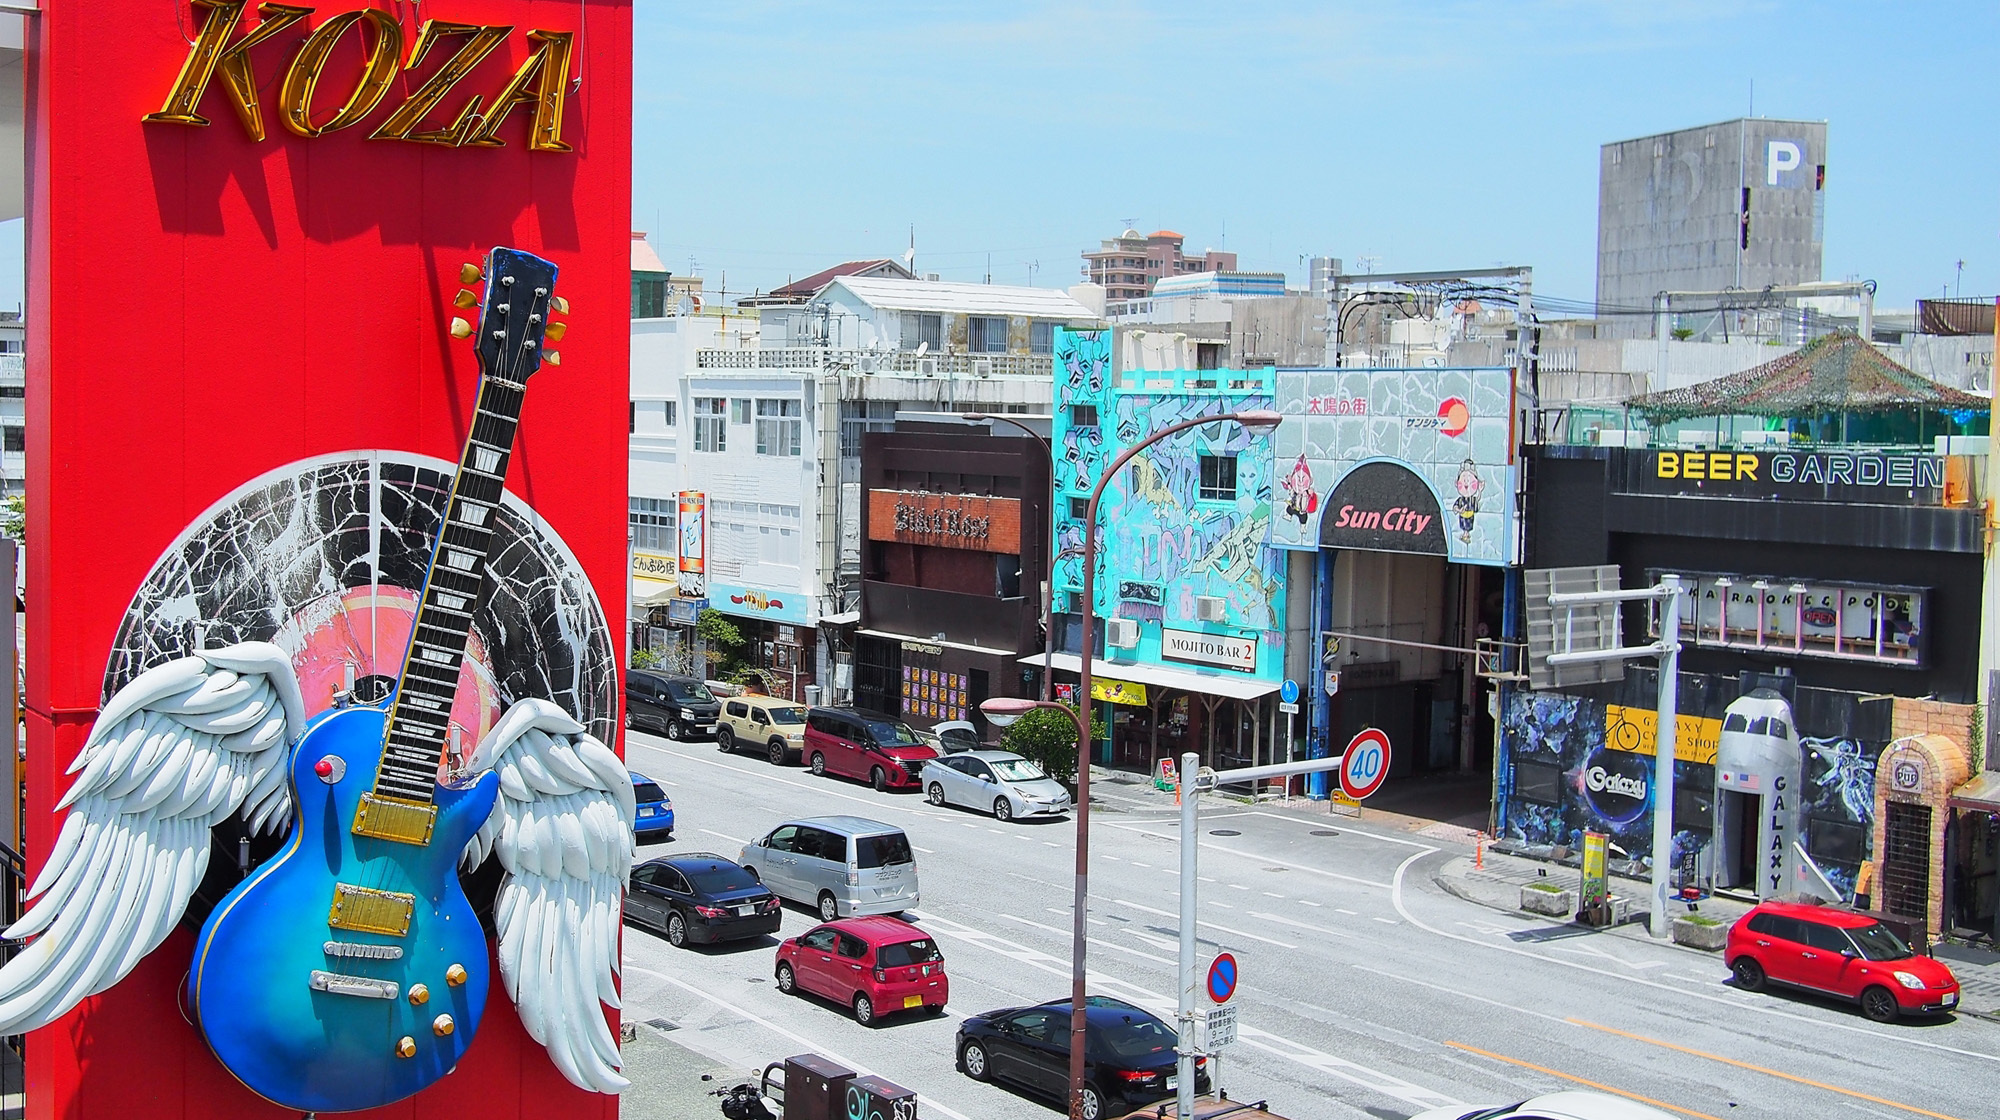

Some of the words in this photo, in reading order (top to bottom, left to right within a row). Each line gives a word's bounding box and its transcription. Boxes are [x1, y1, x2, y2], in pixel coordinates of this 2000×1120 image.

[142, 0, 573, 152] KOZA
[1767, 140, 1801, 186] P
[1309, 398, 1367, 415] 太陽の街
[1406, 418, 1447, 428] サンシティ
[1658, 452, 1759, 481] BEER
[1771, 454, 1945, 488] GARDEN
[893, 503, 942, 535] Black
[1335, 504, 1381, 530] Sun
[1382, 507, 1431, 534] City
[1689, 587, 1812, 606] KARAOKE
[1848, 596, 1911, 613] POOL
[1803, 611, 1837, 624] OPEN
[779, 633, 794, 643] COFFEE
[1171, 638, 1214, 655] MOJITO
[1217, 644, 1240, 658] BAR
[1243, 644, 1252, 660] 2
[1643, 716, 1702, 733] GAXY
[1642, 731, 1679, 745] CYE
[1351, 748, 1379, 780] 40
[1585, 766, 1646, 800] Galaxy
[1897, 771, 1917, 783] PUB
[1770, 776, 1786, 890] GALAXY
[1209, 1034, 1235, 1048] 枠内に限る
